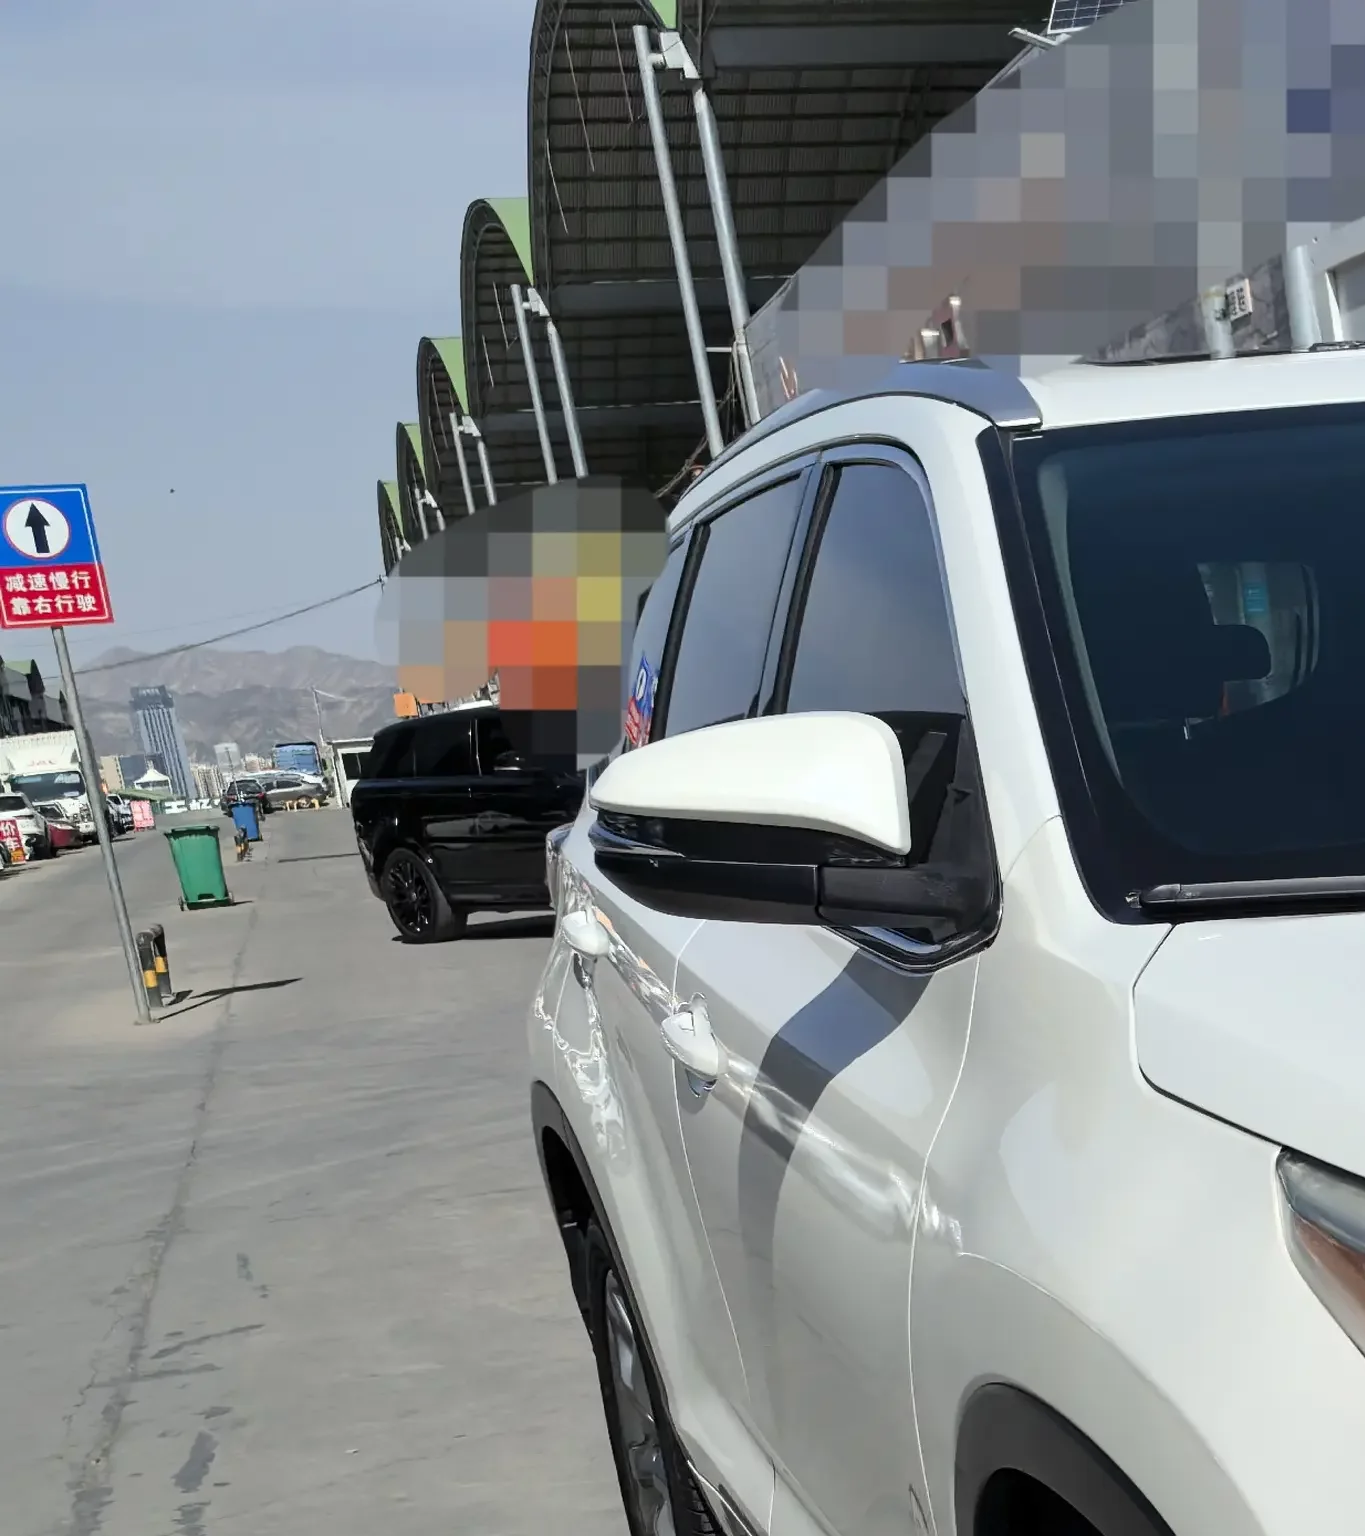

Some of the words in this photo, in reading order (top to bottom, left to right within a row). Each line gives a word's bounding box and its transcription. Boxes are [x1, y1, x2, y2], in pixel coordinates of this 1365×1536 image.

[4, 571, 91, 592] 减速慢行
[9, 594, 98, 616] 靠右行驶
